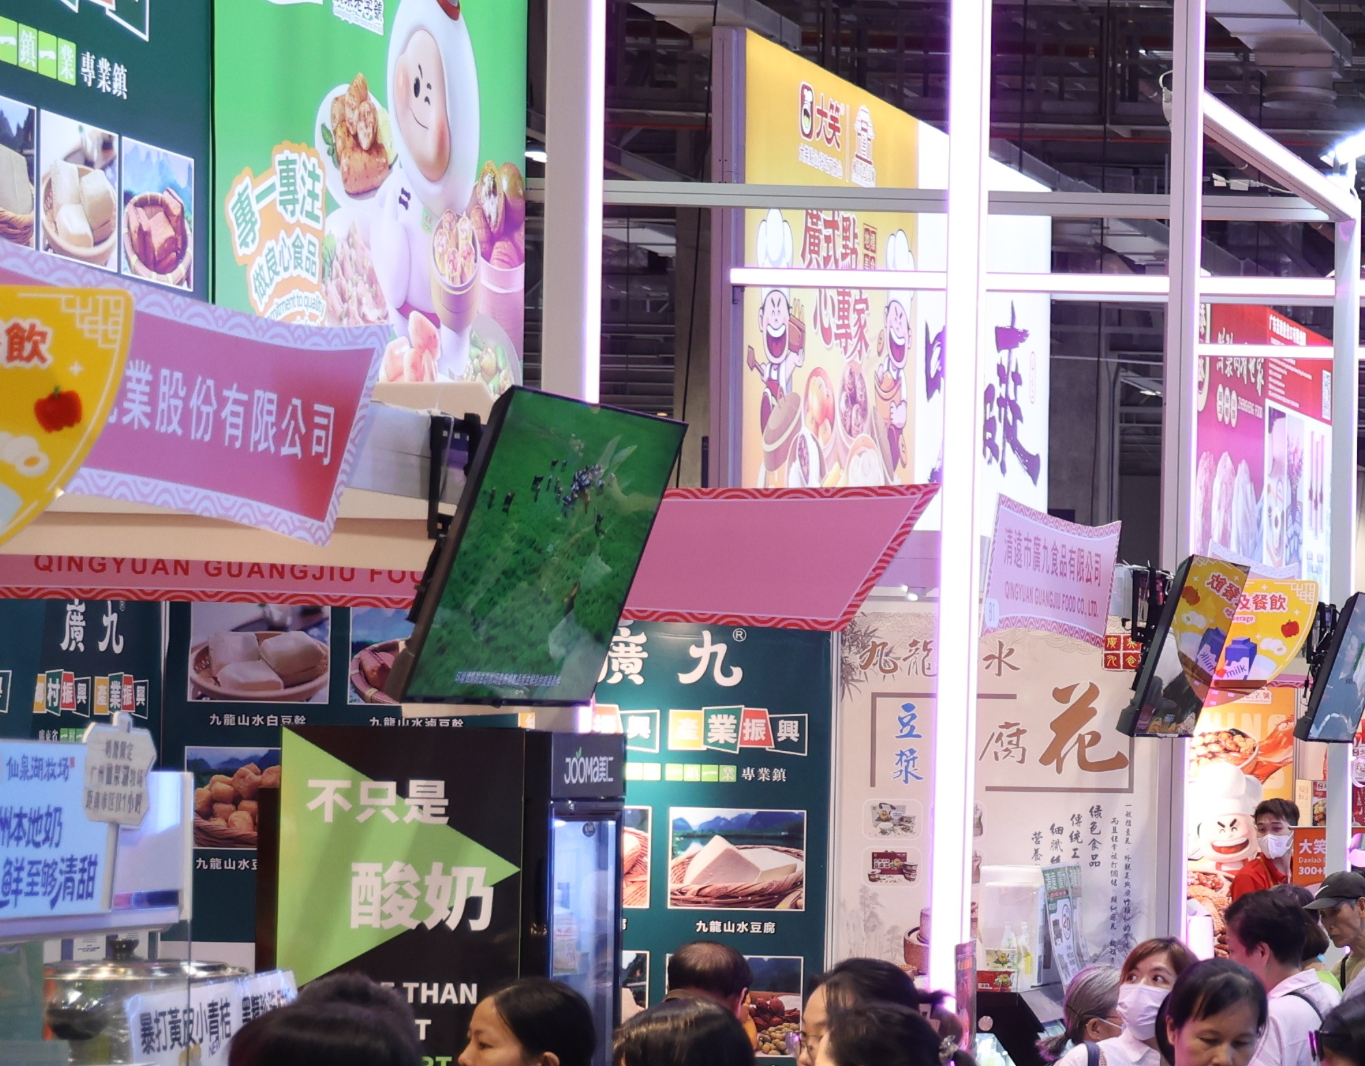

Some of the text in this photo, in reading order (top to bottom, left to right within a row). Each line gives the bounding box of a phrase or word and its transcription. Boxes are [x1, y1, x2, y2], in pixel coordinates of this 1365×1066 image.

[107, 360, 335, 466] 業股份有限公司
[1061, 593, 1077, 613] FOOD
[60, 599, 124, 654] 廣九
[1226, 664, 1247, 678] milk
[675, 714, 801, 745] 產業振興
[306, 780, 450, 825] 不只是
[350, 861, 494, 932] 酸奶
[695, 921, 777, 934] 九龍山水豆腐
[405, 982, 478, 1005] THAN
